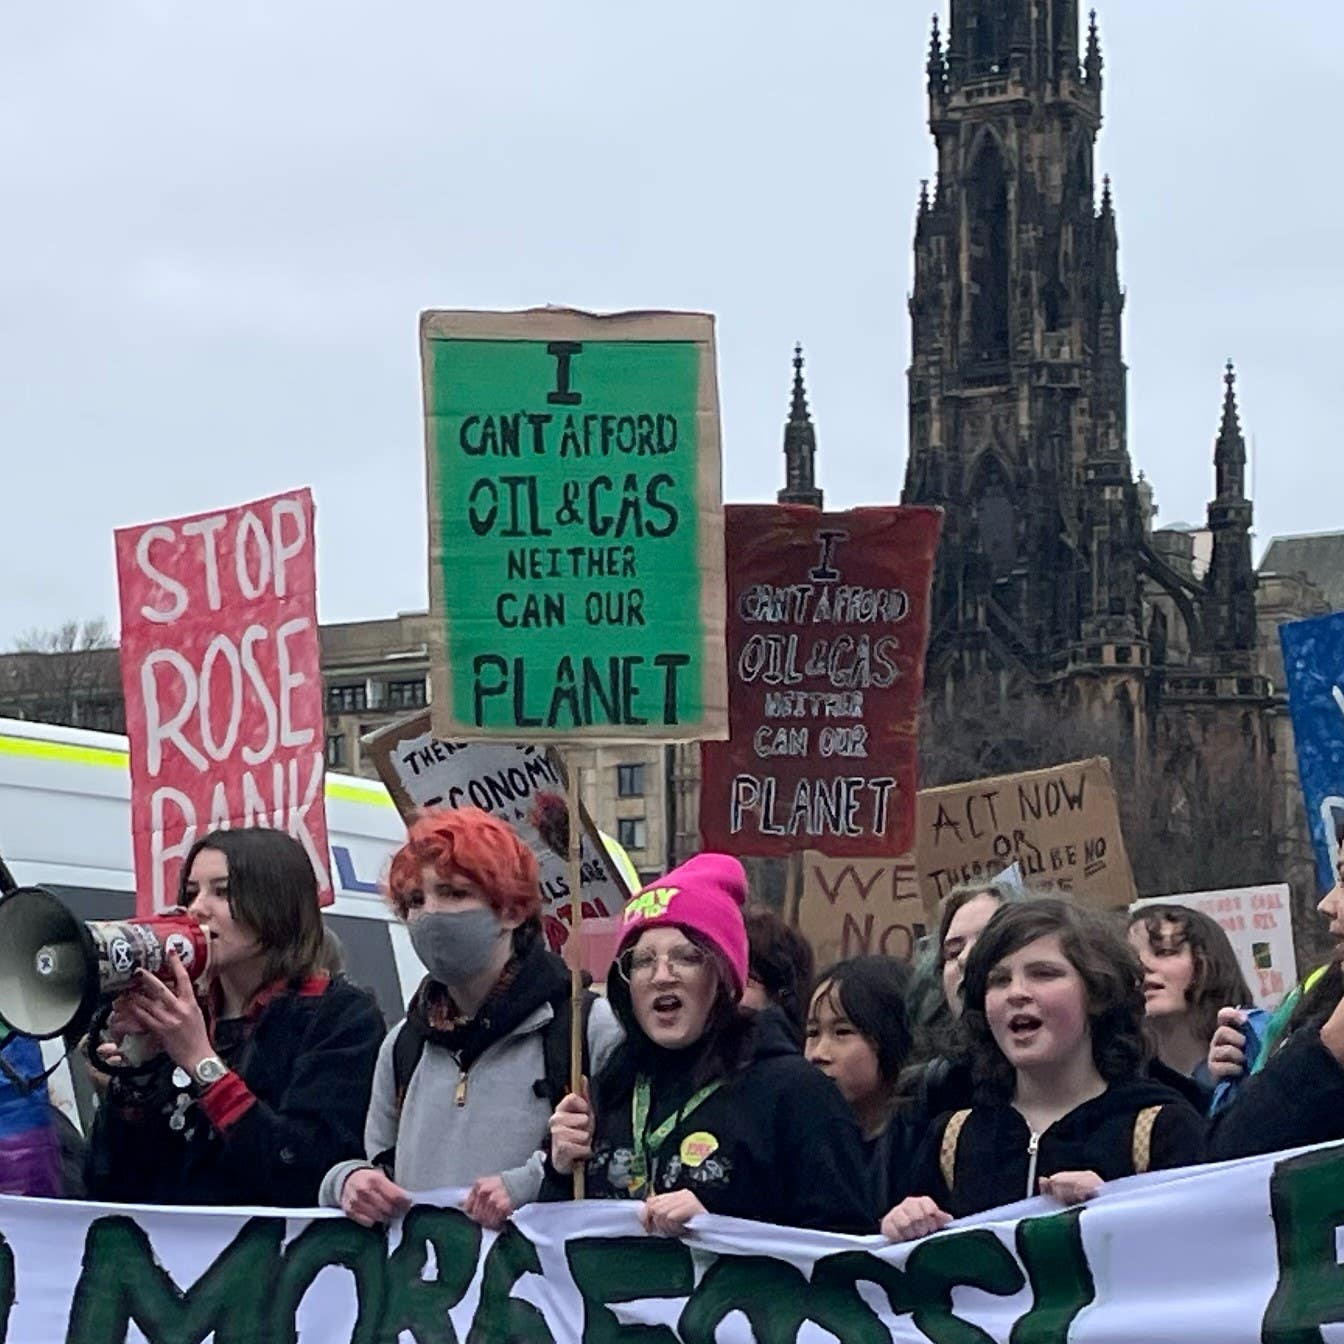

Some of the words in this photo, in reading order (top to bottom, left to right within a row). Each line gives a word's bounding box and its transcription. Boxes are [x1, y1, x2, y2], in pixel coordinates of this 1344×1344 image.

[546, 341, 582, 406] I
[459, 409, 553, 458] CAN'T
[560, 412, 678, 459] AFFORD
[135, 499, 307, 623] STOP
[507, 545, 637, 580] NEITHER
[809, 529, 849, 582] I
[496, 592, 565, 629] CAN
[585, 588, 646, 628] OUR
[812, 585, 910, 625] AFFORD
[140, 617, 315, 776] ROSE
[472, 653, 691, 728] PLANET
[764, 691, 864, 718] NEITHER
[754, 725, 809, 758] CAN
[818, 725, 869, 758] OUR
[424, 755, 559, 812] CONOMY
[730, 774, 897, 837] PLANET
[932, 789, 1000, 846] ACT
[1017, 773, 1087, 822] NOW
[993, 829, 1042, 858] OR
[1050, 844, 1077, 871] BE
[813, 864, 919, 905] WE
